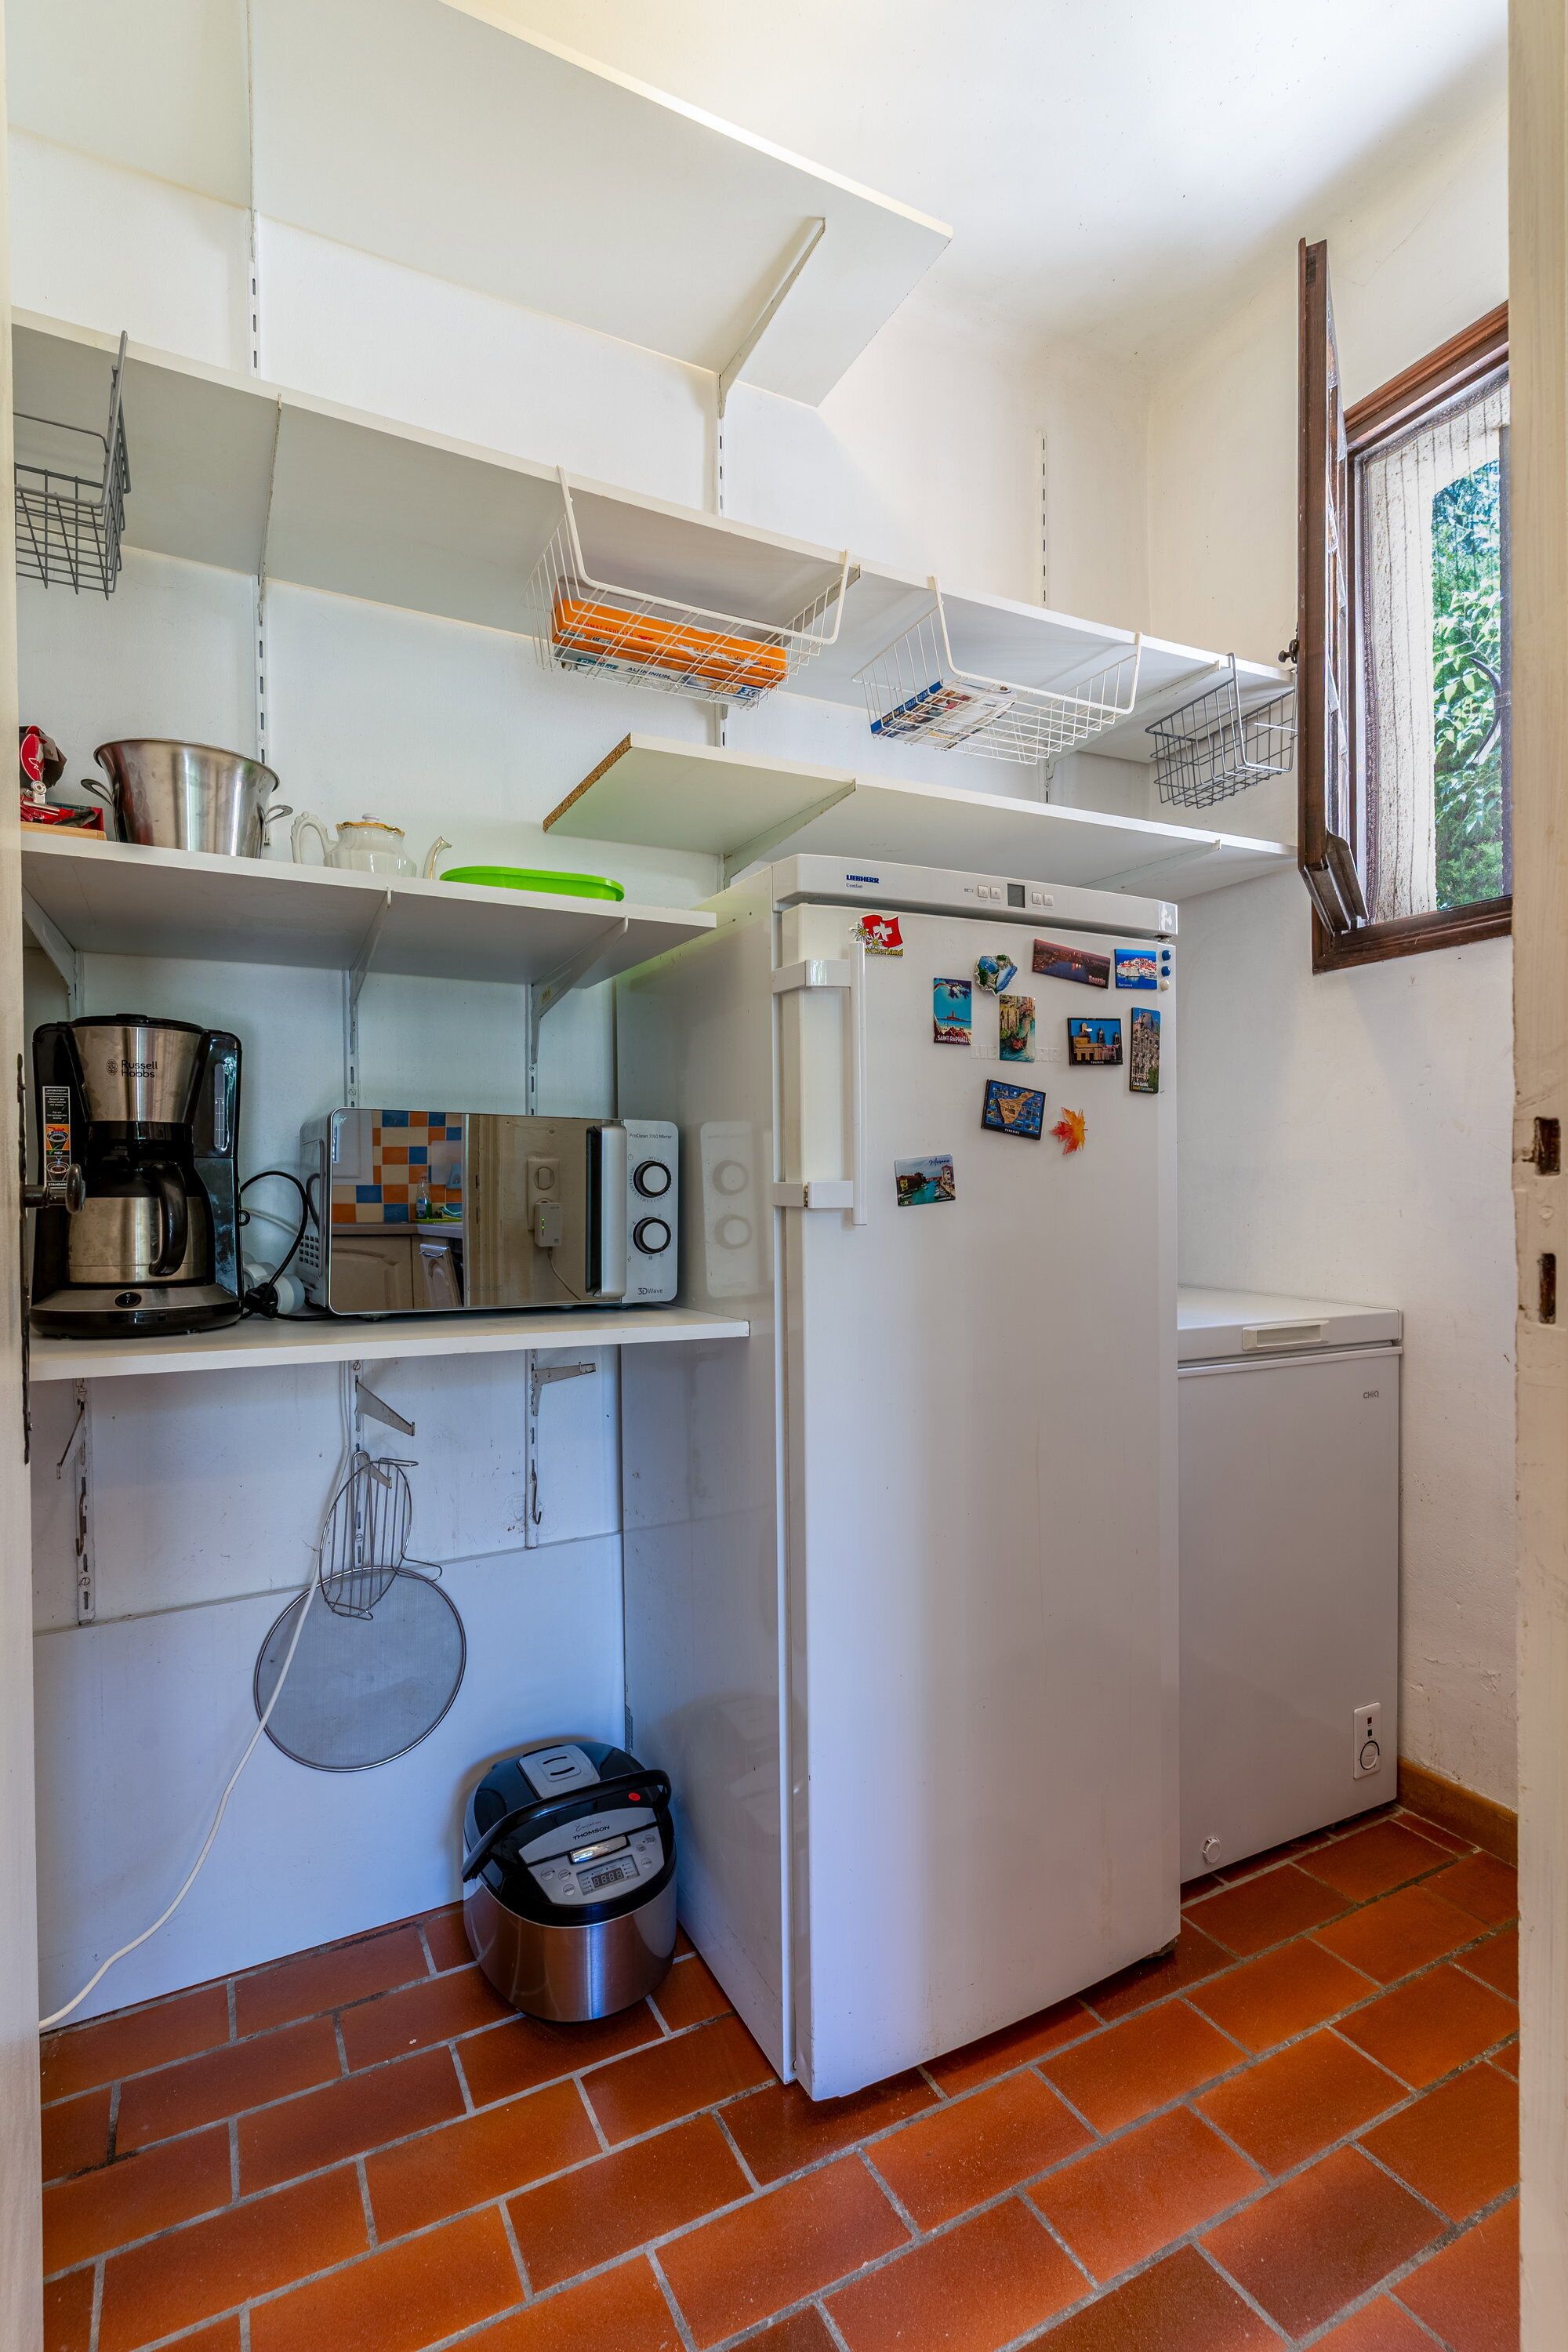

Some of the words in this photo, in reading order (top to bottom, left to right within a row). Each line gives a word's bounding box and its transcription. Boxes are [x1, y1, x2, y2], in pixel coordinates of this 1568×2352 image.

[847, 874, 879, 884] LIEBHERR
[122, 1059, 158, 1069] Russell
[122, 1069, 155, 1078] Hobbs
[573, 1825, 610, 1840] THOMSON
